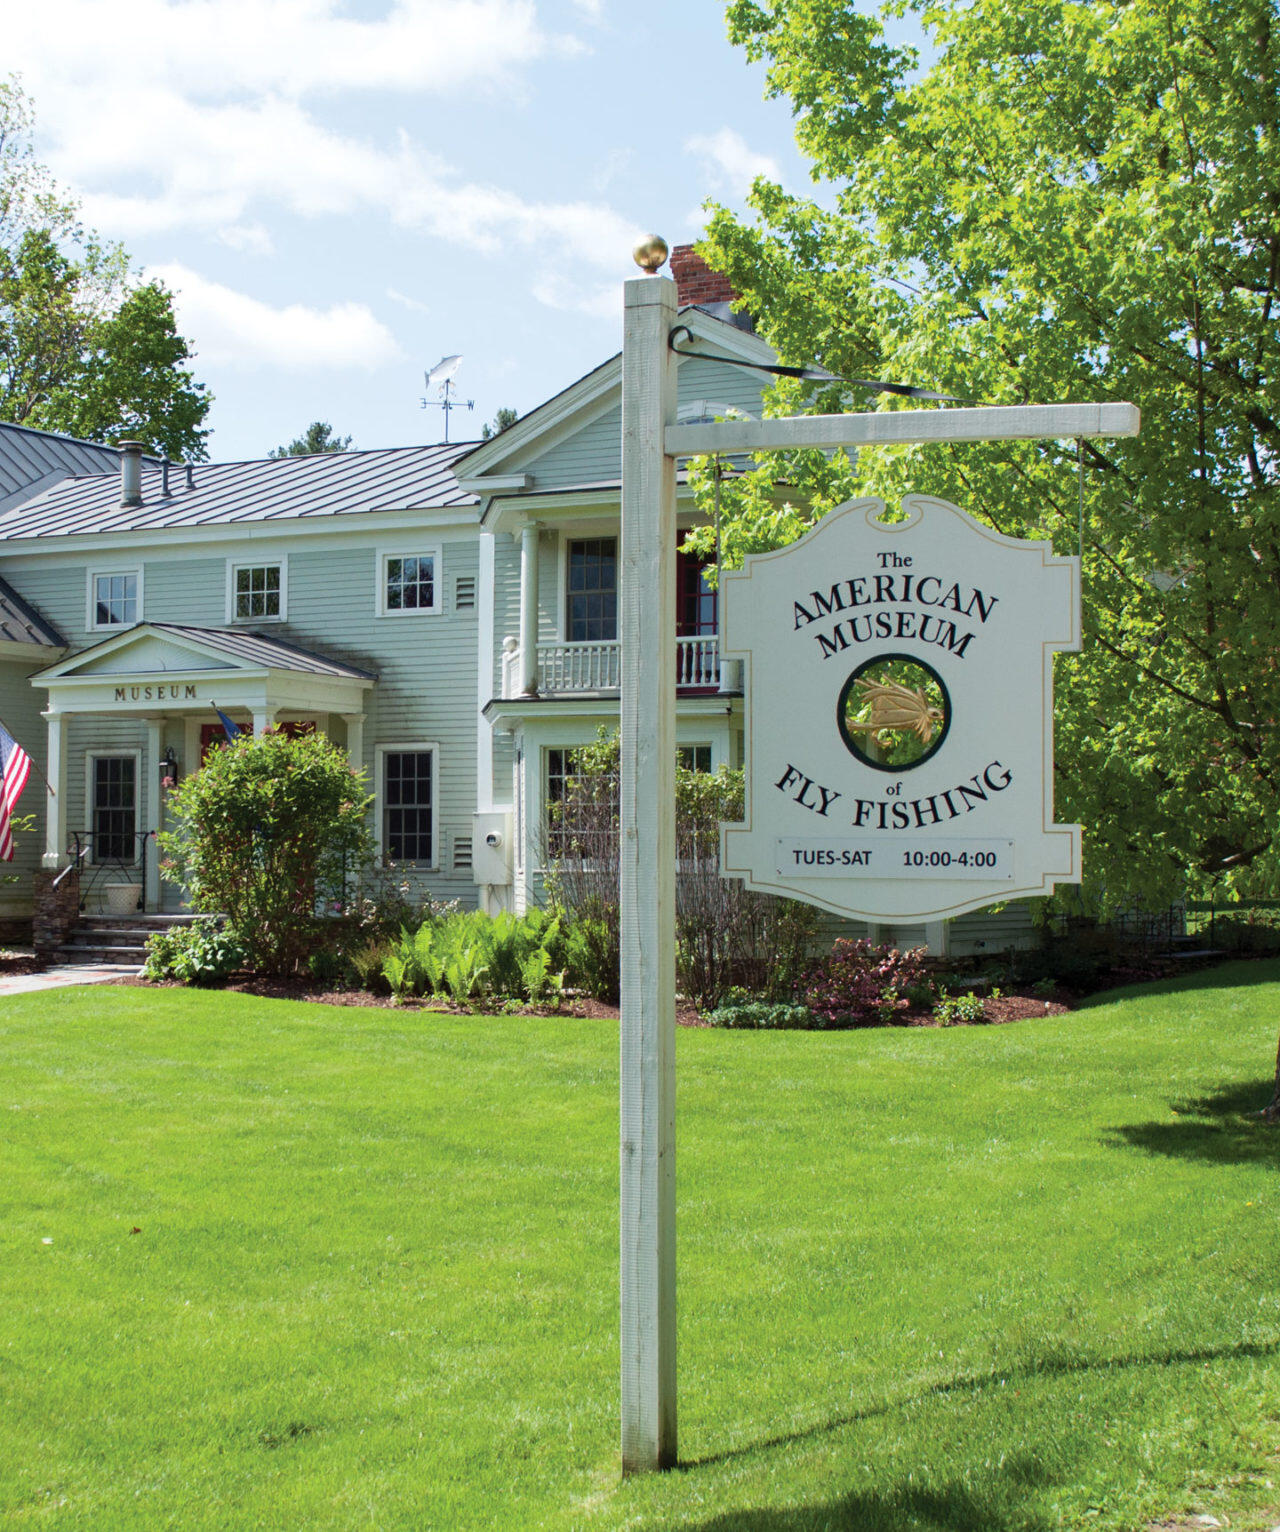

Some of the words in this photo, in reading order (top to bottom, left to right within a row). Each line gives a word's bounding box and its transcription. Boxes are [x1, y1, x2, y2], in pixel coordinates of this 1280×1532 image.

[876, 552, 913, 568] The
[792, 574, 1000, 631] AMERICAN
[814, 611, 976, 660] MUSEUM
[114, 685, 197, 701] MUSEUM
[774, 764, 842, 817] FLY
[851, 760, 1013, 830] FISHING
[885, 782, 903, 797] of
[792, 849, 872, 866] TUES-SAT
[903, 851, 997, 868] 10:00-4:00
